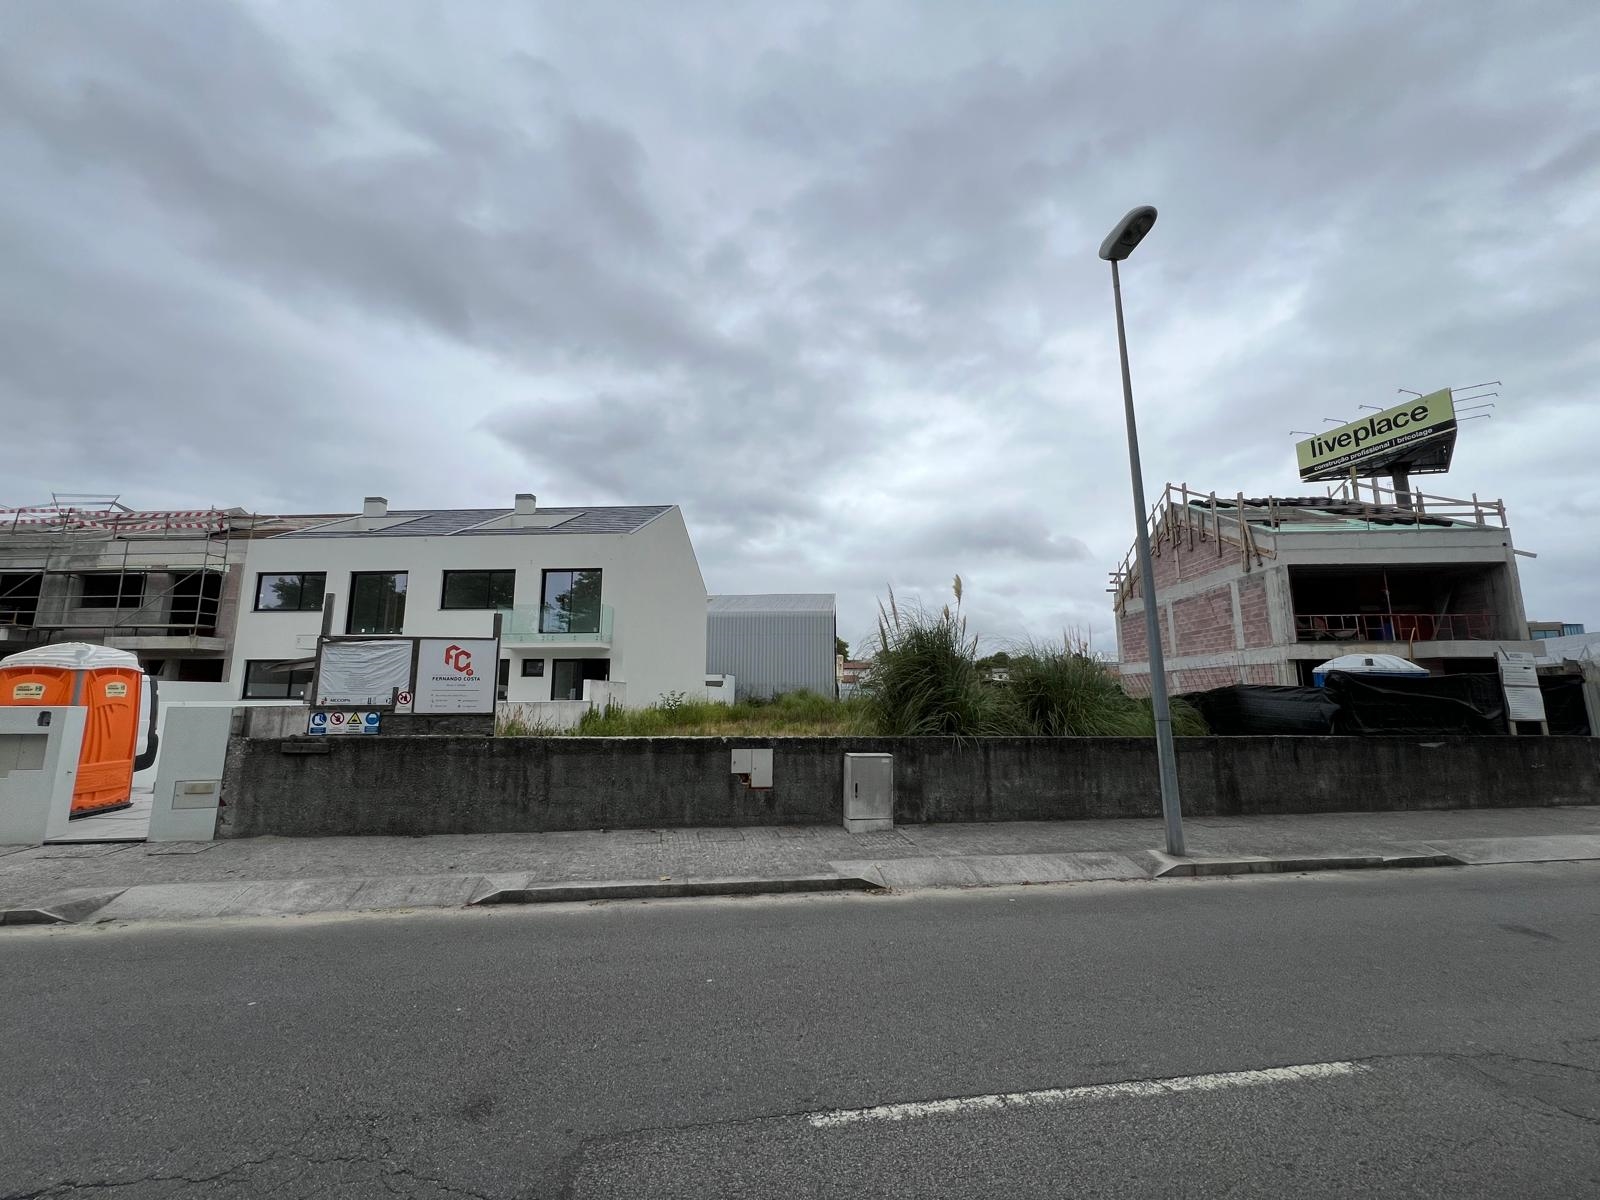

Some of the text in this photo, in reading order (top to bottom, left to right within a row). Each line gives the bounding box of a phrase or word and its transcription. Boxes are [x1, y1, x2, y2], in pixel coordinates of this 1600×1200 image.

[1310, 405, 1429, 458] liveplace
[1314, 455, 1349, 471] construção
[1350, 442, 1390, 460] profissional
[1397, 428, 1433, 444] bricolage
